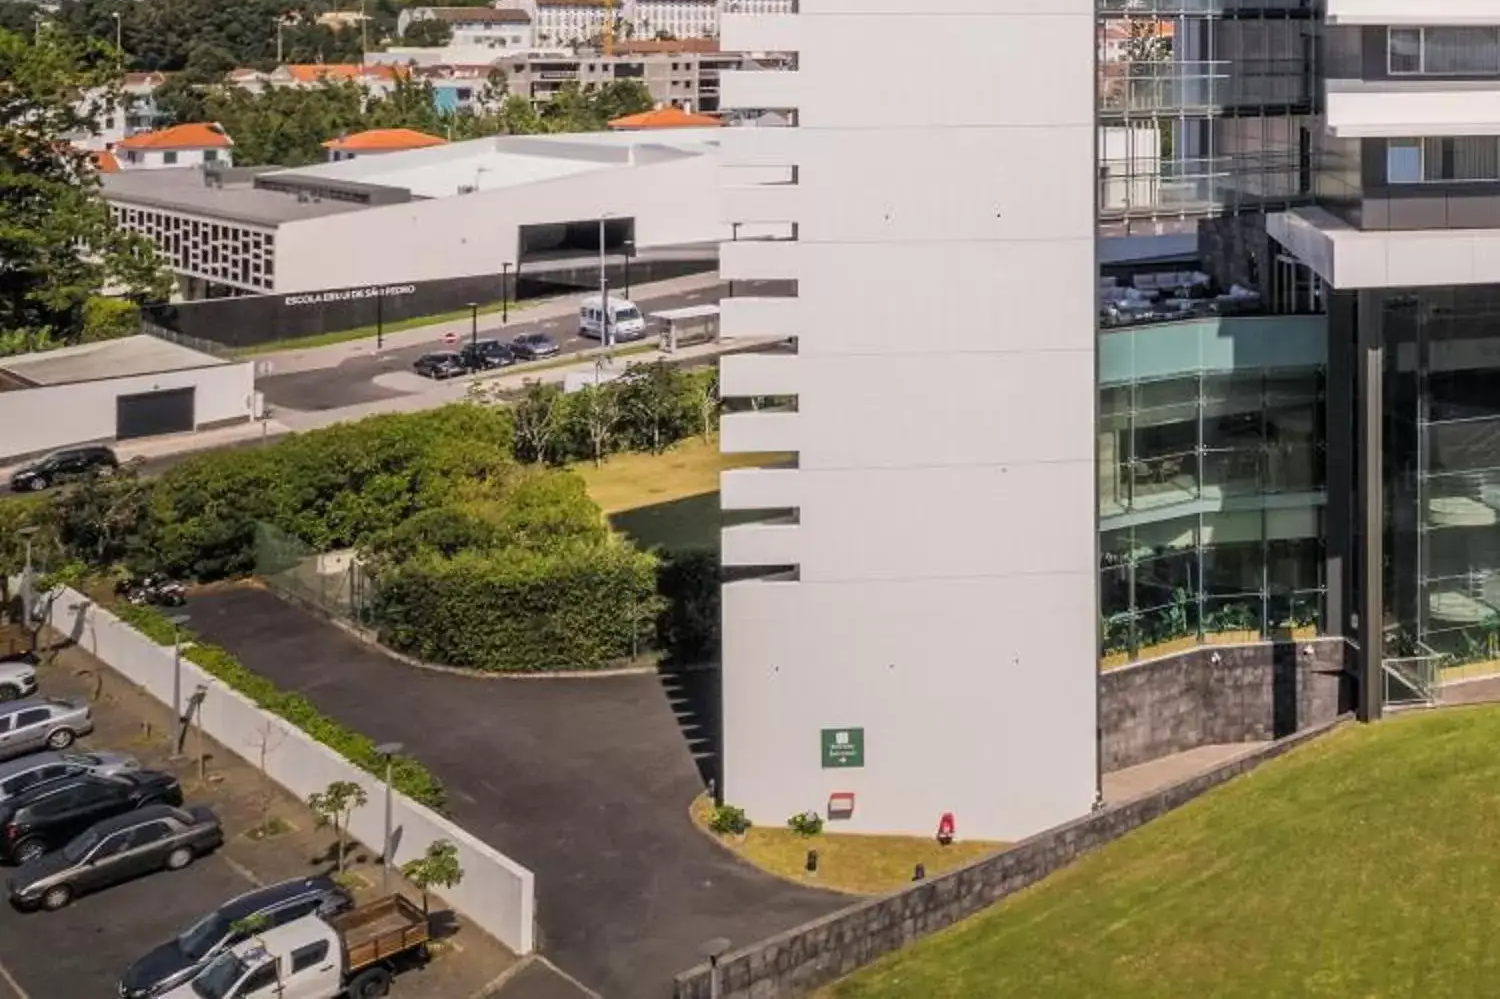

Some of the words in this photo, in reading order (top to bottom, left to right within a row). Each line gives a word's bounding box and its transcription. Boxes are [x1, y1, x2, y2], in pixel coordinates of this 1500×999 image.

[285, 295, 322, 306] ESCOLA
[351, 289, 364, 298] DE
[385, 285, 416, 296] PEDRO
